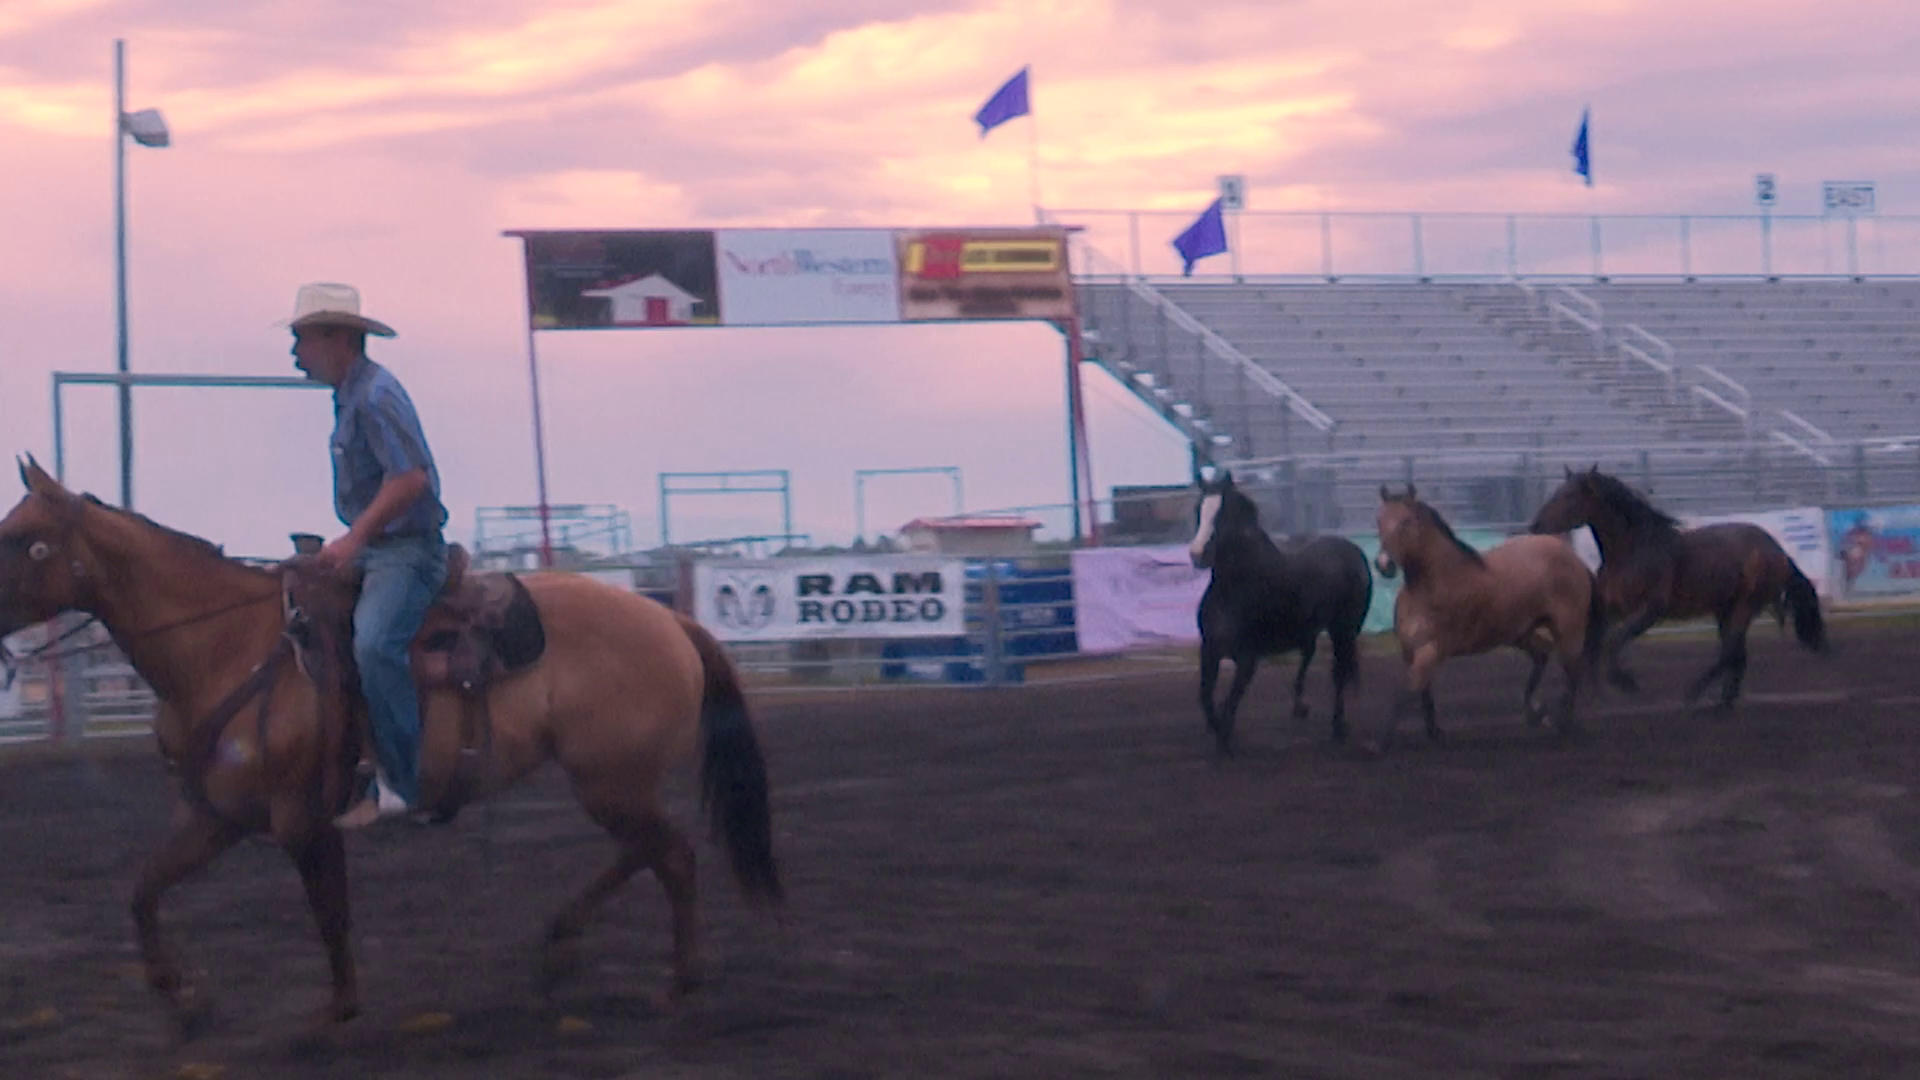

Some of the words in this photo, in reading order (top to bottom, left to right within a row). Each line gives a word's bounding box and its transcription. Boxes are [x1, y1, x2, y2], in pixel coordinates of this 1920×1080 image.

[1825, 186, 1874, 208] EAST
[797, 571, 943, 597] RAM
[797, 597, 946, 625] RODEO
